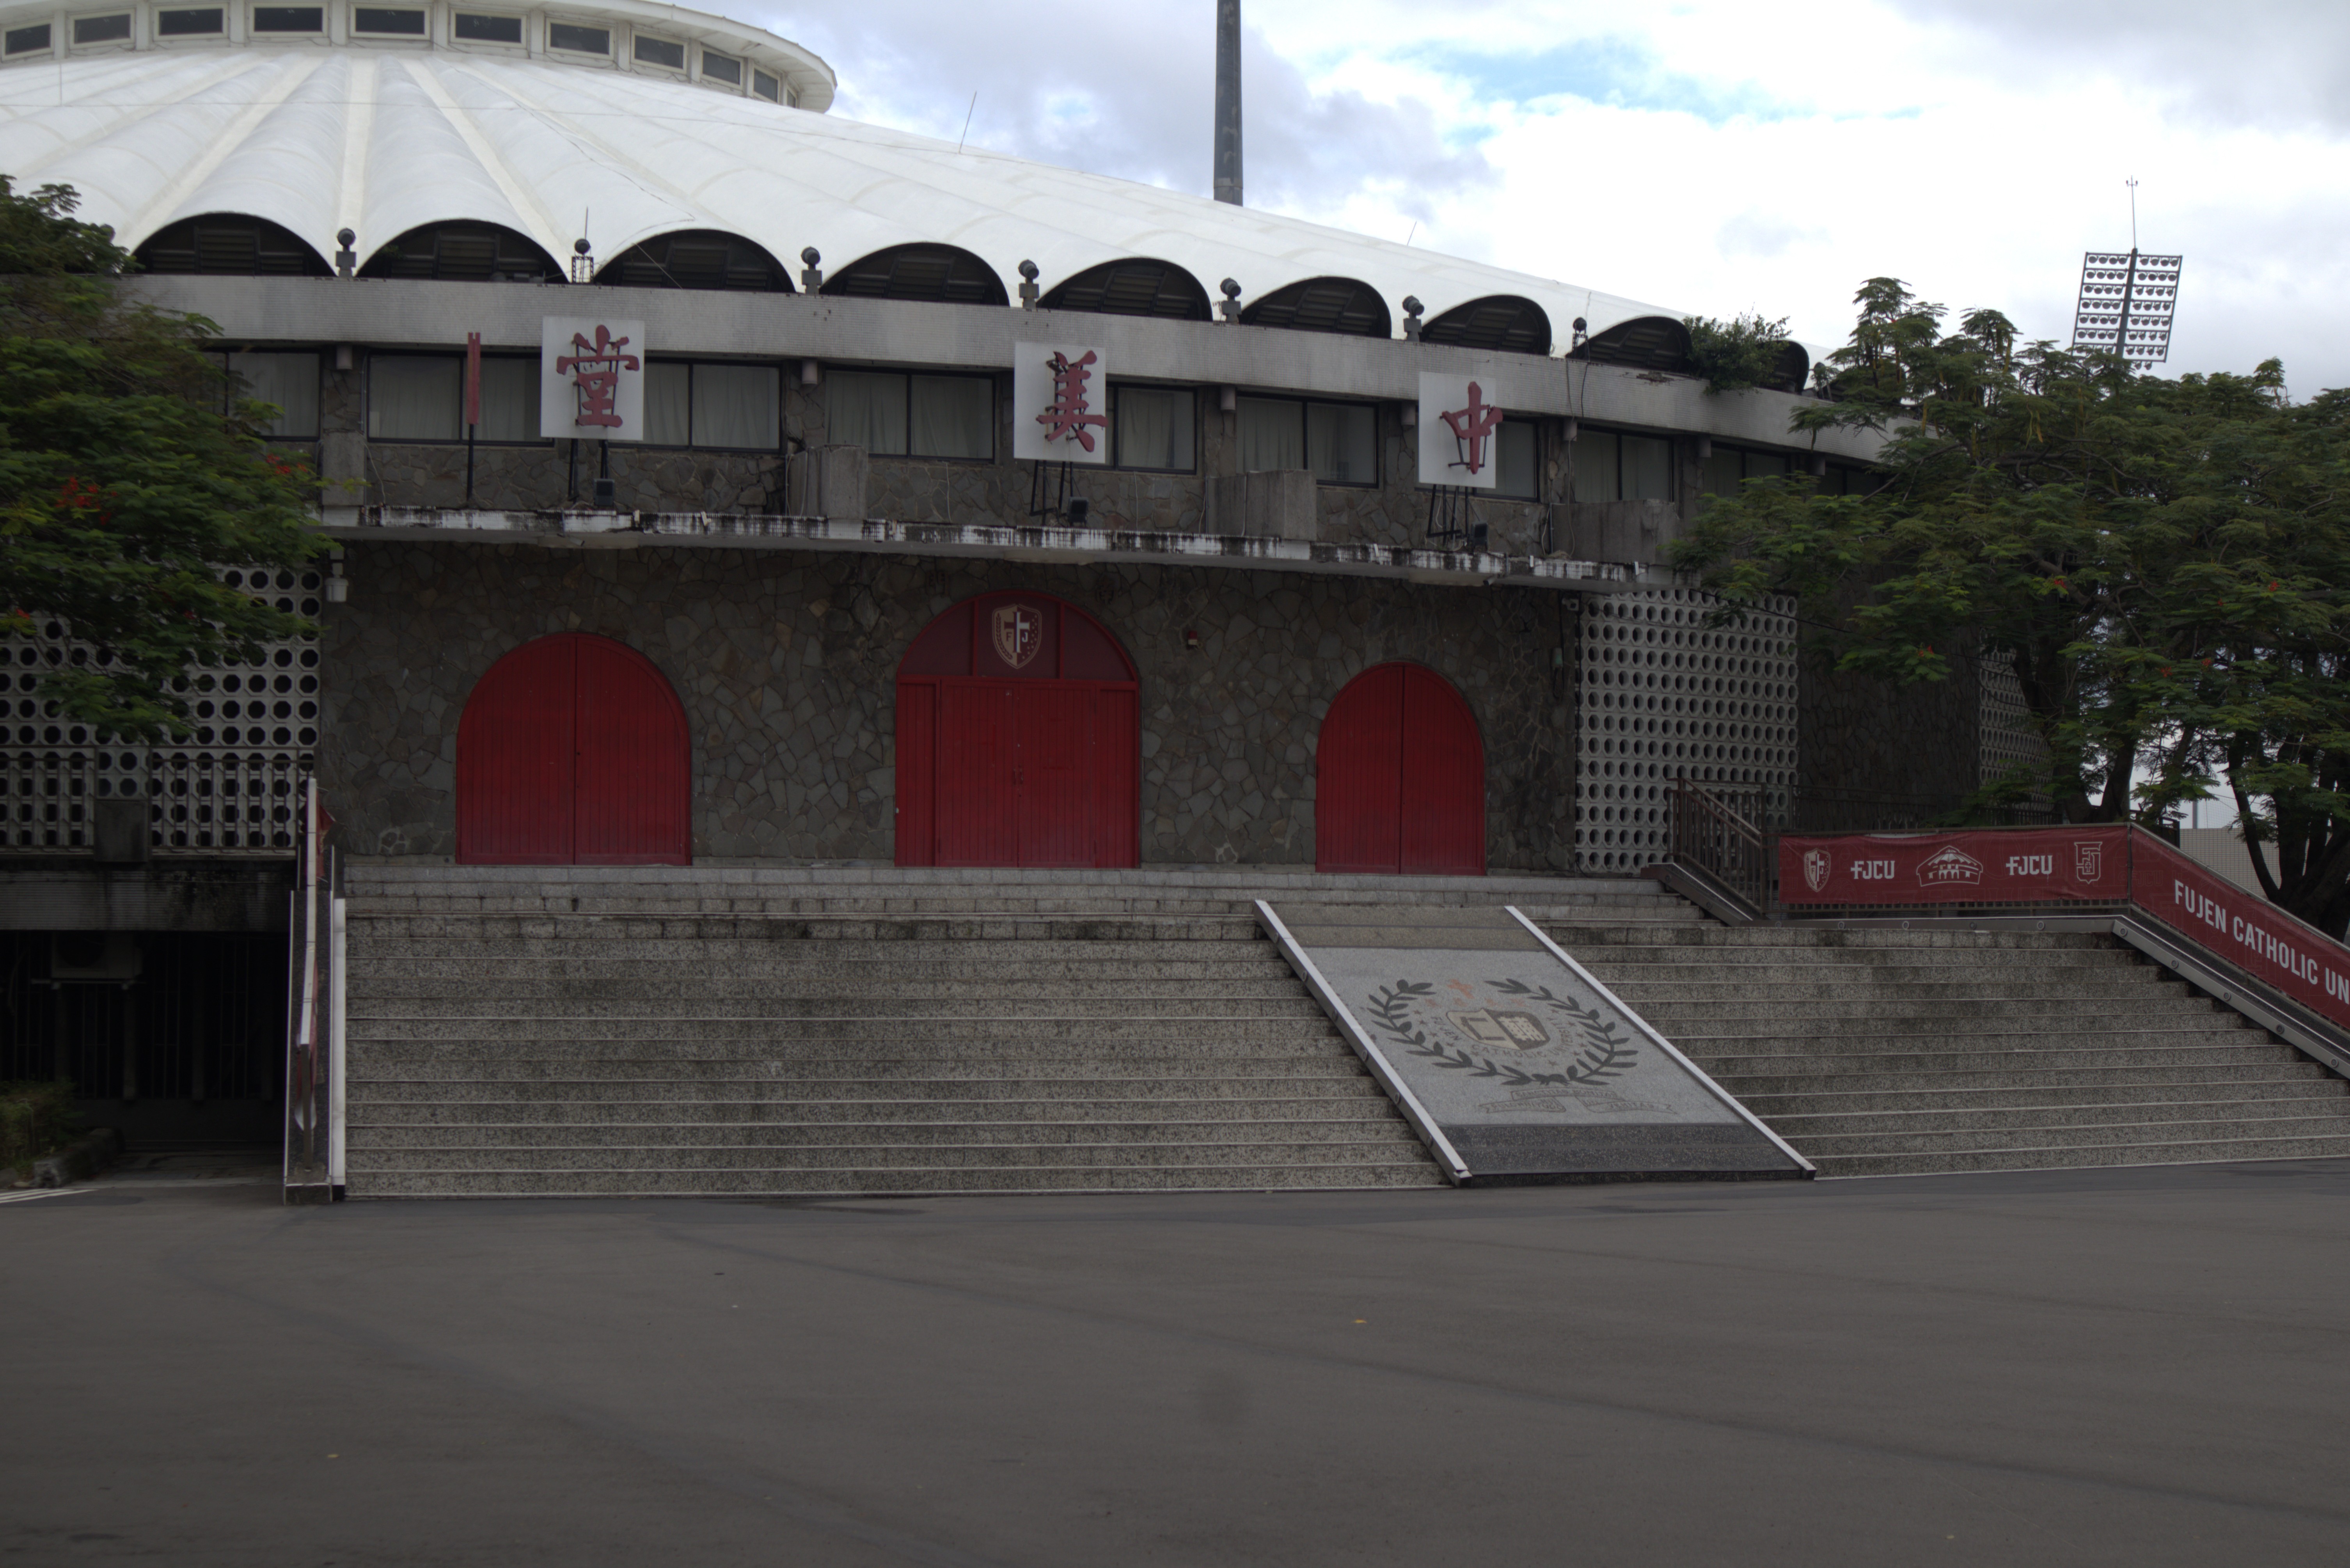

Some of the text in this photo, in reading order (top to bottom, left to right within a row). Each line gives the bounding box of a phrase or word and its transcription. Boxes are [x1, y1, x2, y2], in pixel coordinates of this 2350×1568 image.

[556, 325, 1503, 475] 中 美 堂
[1851, 860, 1895, 879] FJCU
[2006, 855, 2053, 876] FJCU
[2175, 880, 2226, 933] FUJEN
[2233, 916, 2318, 985] CATHOLIC
[1471, 1044, 1547, 1058] CATHOLIC
